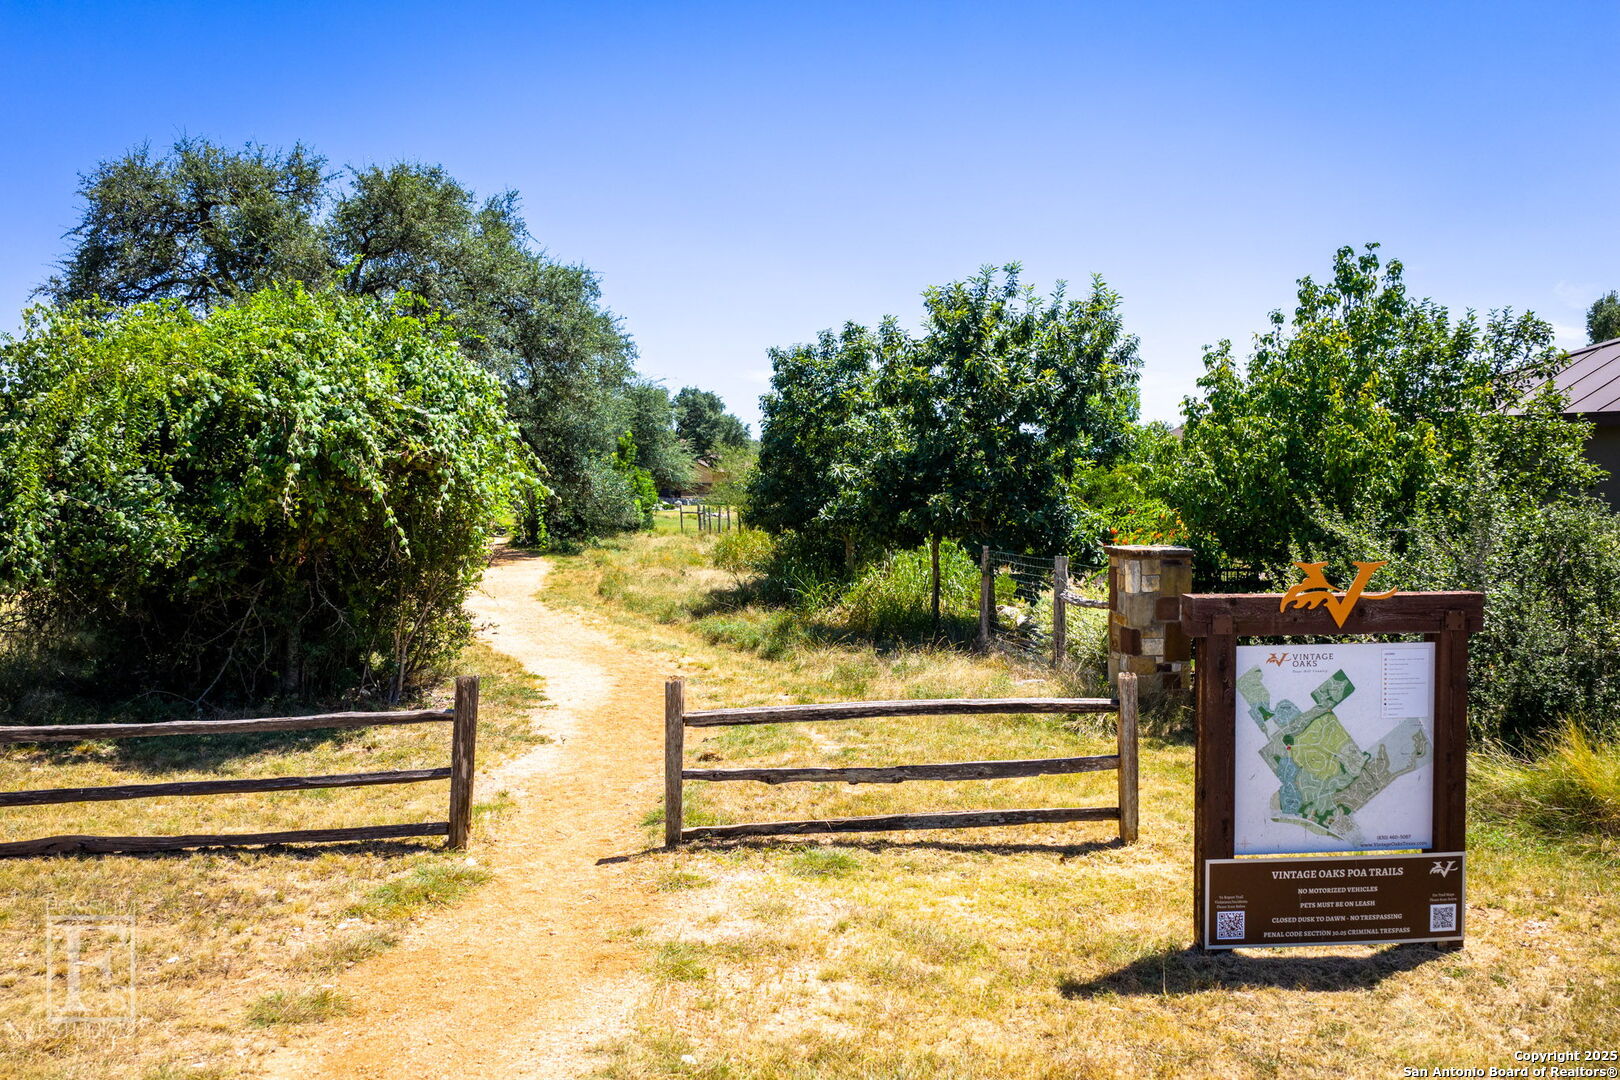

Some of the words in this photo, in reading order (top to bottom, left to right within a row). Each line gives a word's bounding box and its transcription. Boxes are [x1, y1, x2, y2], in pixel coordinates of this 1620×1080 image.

[1292, 660, 1318, 668] OAKS
[1271, 870, 1317, 880] VINTAGE
[1318, 869, 1346, 879] OAKS
[1347, 868, 1368, 878] POA
[1368, 867, 1404, 877] TRAILS
[1360, 913, 1403, 921] TRESPASSING
[1347, 928, 1380, 936] CRIMINAL
